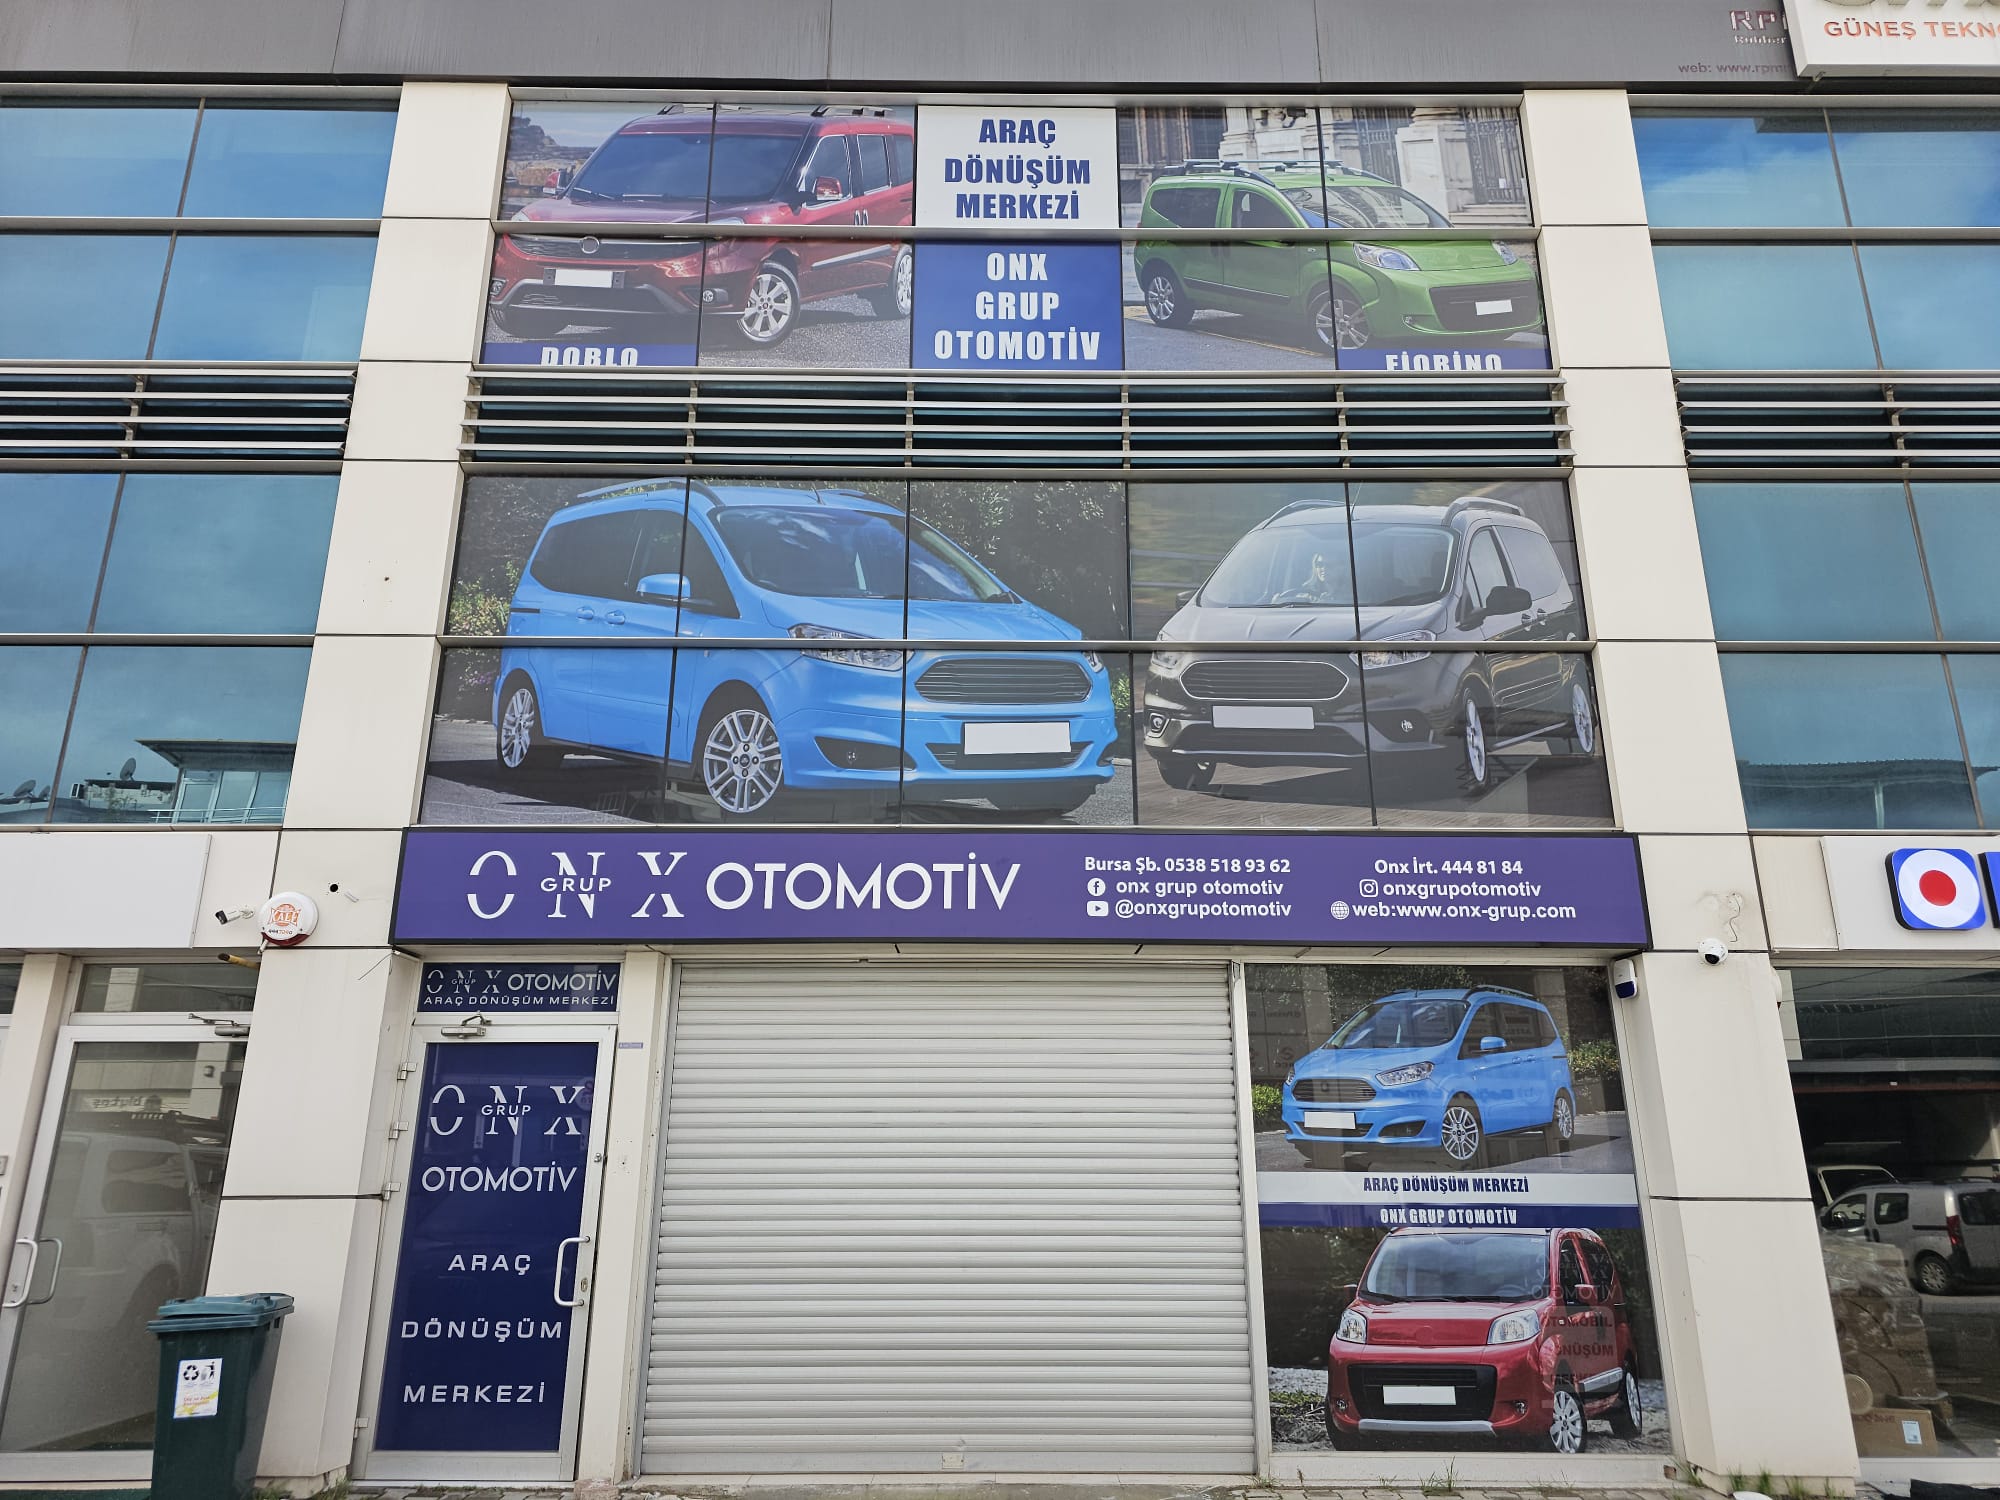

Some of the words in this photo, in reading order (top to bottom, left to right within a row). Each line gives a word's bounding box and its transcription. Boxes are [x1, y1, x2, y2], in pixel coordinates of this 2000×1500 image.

[1730, 10, 1788, 30] RP
[1824, 18, 1917, 40] GÜNEŞ
[1923, 21, 2000, 38] TEKN
[1678, 63, 1712, 73] web:
[979, 120, 1056, 149] ARAÇ
[944, 154, 1091, 187] DÖNÜŞÜM
[955, 189, 1080, 220] MERKEZİ
[987, 253, 1048, 281] ONX
[975, 291, 1060, 321] GRUP
[934, 326, 1101, 361] OTOMOTİV
[1085, 857, 1131, 871] Bursa
[1135, 857, 1161, 875] Şb.
[1164, 858, 1206, 872] 0538
[1210, 859, 1242, 872] 518
[1244, 859, 1266, 873] 93
[1269, 859, 1291, 873] 62
[1374, 859, 1409, 874] Onx
[1412, 857, 1438, 874] İrt.
[1441, 860, 1474, 874] 444
[1476, 860, 1496, 874] 81
[1501, 860, 1524, 874] 84
[467, 850, 688, 920] ONX
[706, 852, 1021, 911] OTOMOTİV
[540, 877, 612, 892] GRUP
[1116, 883, 1150, 894] onx
[1155, 883, 1198, 898] grup
[1202, 879, 1284, 895] otomotiv
[1382, 881, 1542, 899] onxgrupotomotiv
[268, 907, 301, 927] KALE
[1115, 899, 1292, 919] @onxgrupotomotiv
[1352, 902, 1577, 921] web:www.onx-grup.com
[426, 969, 502, 994] ONX
[507, 970, 617, 991] OTOMOTİV
[451, 978, 477, 986] GRUP
[424, 996, 463, 1006] ARAÇ
[468, 995, 544, 1007] DÖNÜŞÜM
[549, 995, 615, 1006] MERKEZİ
[429, 1084, 586, 1136] ONX
[481, 1104, 532, 1116] GRUP
[421, 1161, 578, 1192] OTOMOTİV
[1363, 1177, 1399, 1195] ARAÇ
[1402, 1176, 1469, 1195] DÖNÜŞÜM
[1472, 1176, 1530, 1193] MERKEZİ
[1380, 1208, 1408, 1224] ONX
[1409, 1207, 1444, 1225] GRUP
[1448, 1206, 1518, 1225] OTOMOTİV
[447, 1254, 532, 1276] ARAÇ
[400, 1317, 562, 1343] DÖNÜŞÜM
[403, 1381, 545, 1403] MERKEZİ
